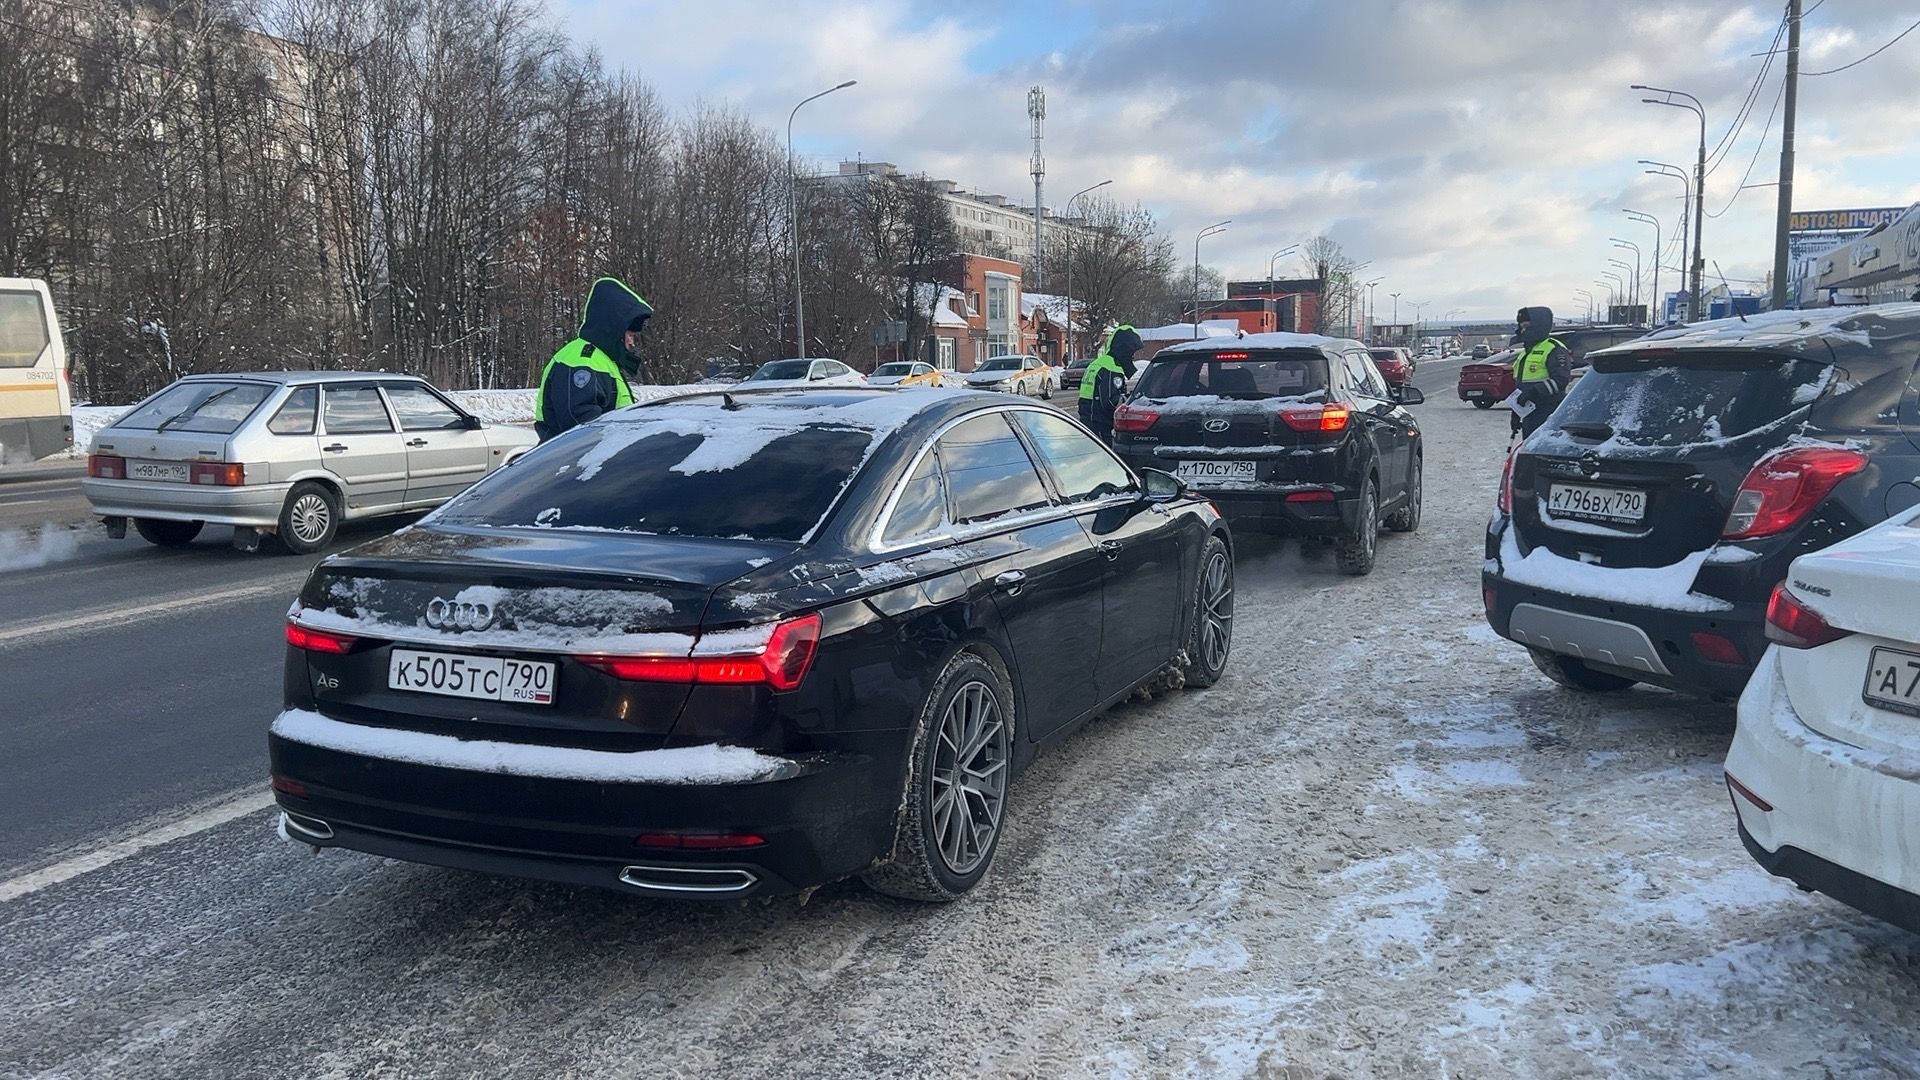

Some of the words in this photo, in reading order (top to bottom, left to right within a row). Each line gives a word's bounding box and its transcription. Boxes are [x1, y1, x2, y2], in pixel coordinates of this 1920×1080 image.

[26, 371, 54, 380] 084702
[1233, 462, 1253, 472] 750
[1554, 488, 1612, 514] К796ВХ
[1615, 492, 1640, 510] 790
[316, 673, 339, 689] A6
[396, 655, 499, 695] К505ТС
[506, 662, 548, 690] 790
[513, 688, 534, 700] RUS
